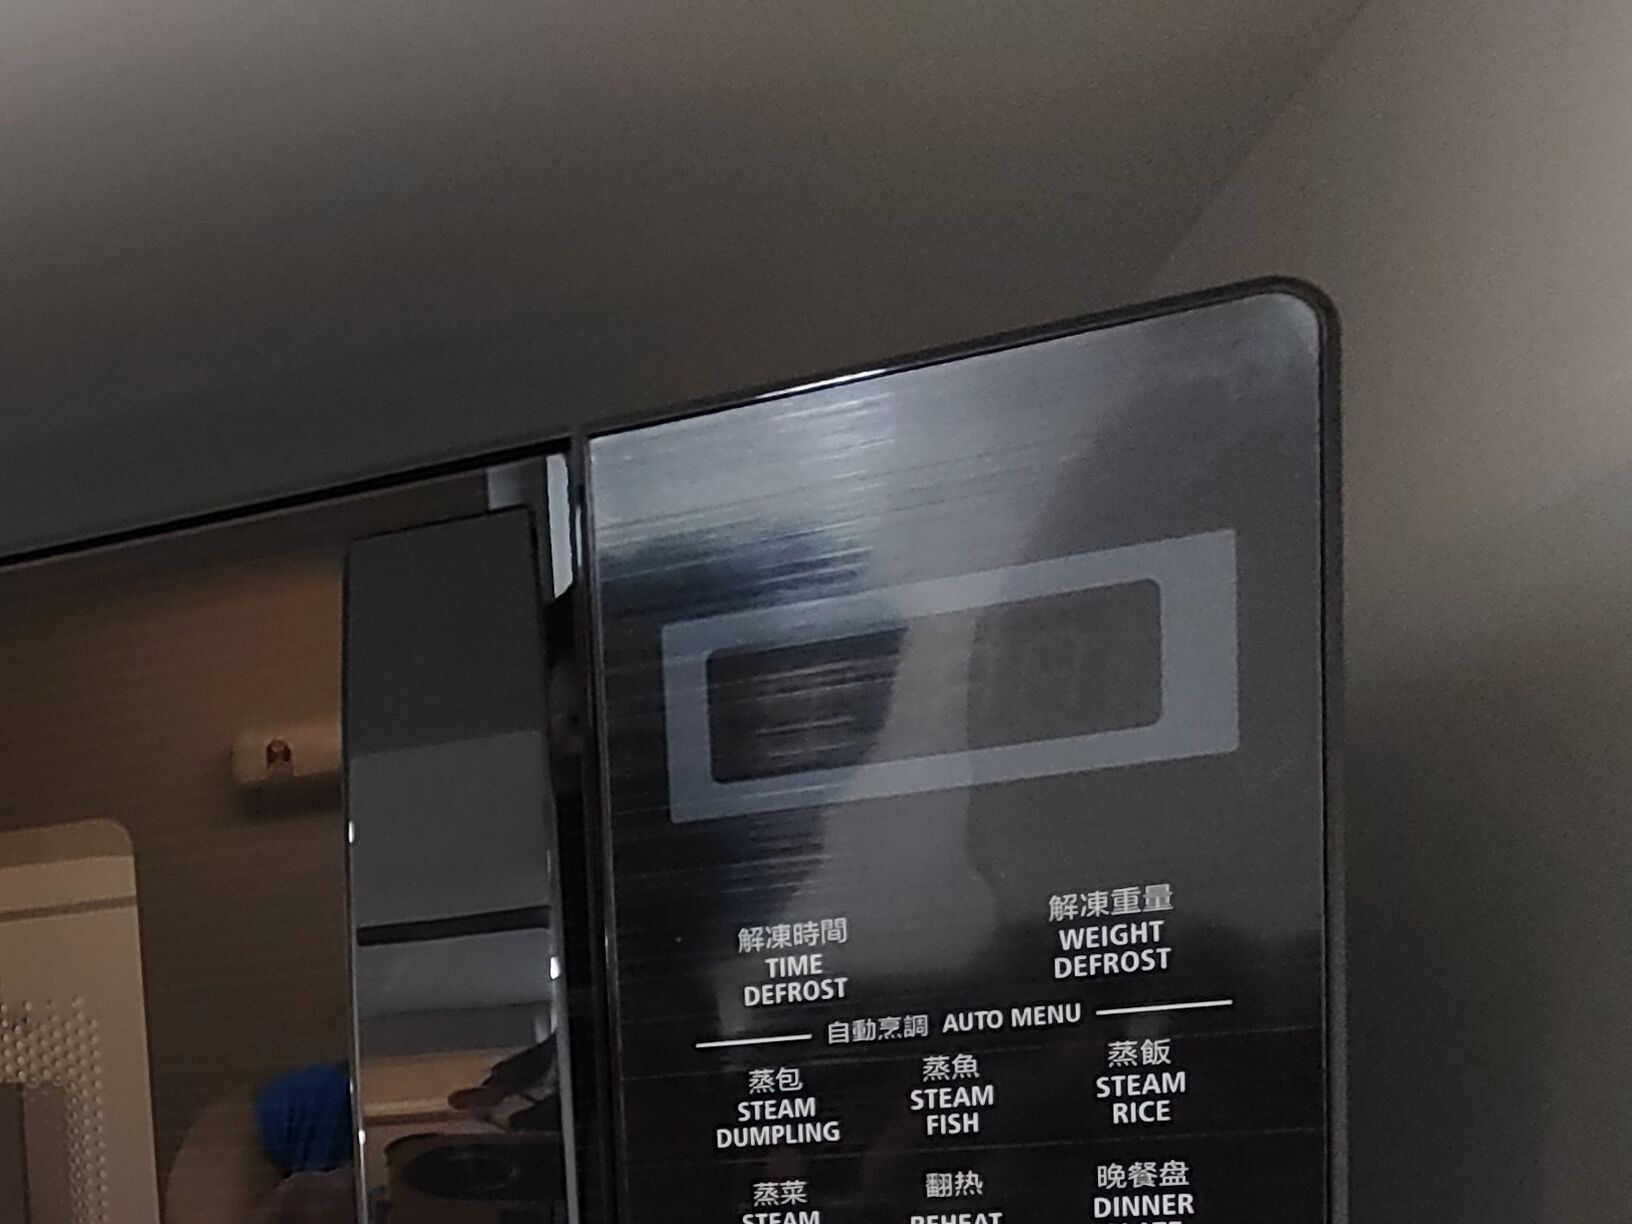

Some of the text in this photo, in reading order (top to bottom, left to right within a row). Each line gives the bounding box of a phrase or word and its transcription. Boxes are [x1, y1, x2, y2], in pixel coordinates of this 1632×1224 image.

[1048, 883, 1173, 922] 解凍重量
[738, 917, 848, 953] 解凍時間
[1059, 920, 1165, 951] WEIGHT
[765, 953, 824, 978] TIME
[1054, 947, 1172, 979] DEFROST
[744, 977, 848, 1007] DEFROST
[827, 1013, 929, 1045] 自動烹調
[942, 1002, 1082, 1033] AUTO MENU
[922, 1053, 980, 1082] 蒸魚
[1107, 1038, 1172, 1069] 蒸飯
[748, 1067, 804, 1095] 蒸包
[1095, 1071, 1187, 1099] STEAM
[737, 1096, 817, 1122] STEAM
[910, 1084, 995, 1110] STEAM
[1112, 1099, 1172, 1124] RICE
[716, 1120, 841, 1149] DUMPLING
[926, 1112, 980, 1136] FISH
[752, 1179, 808, 1207] 蒸菜
[1093, 1193, 1195, 1219] DINNER
